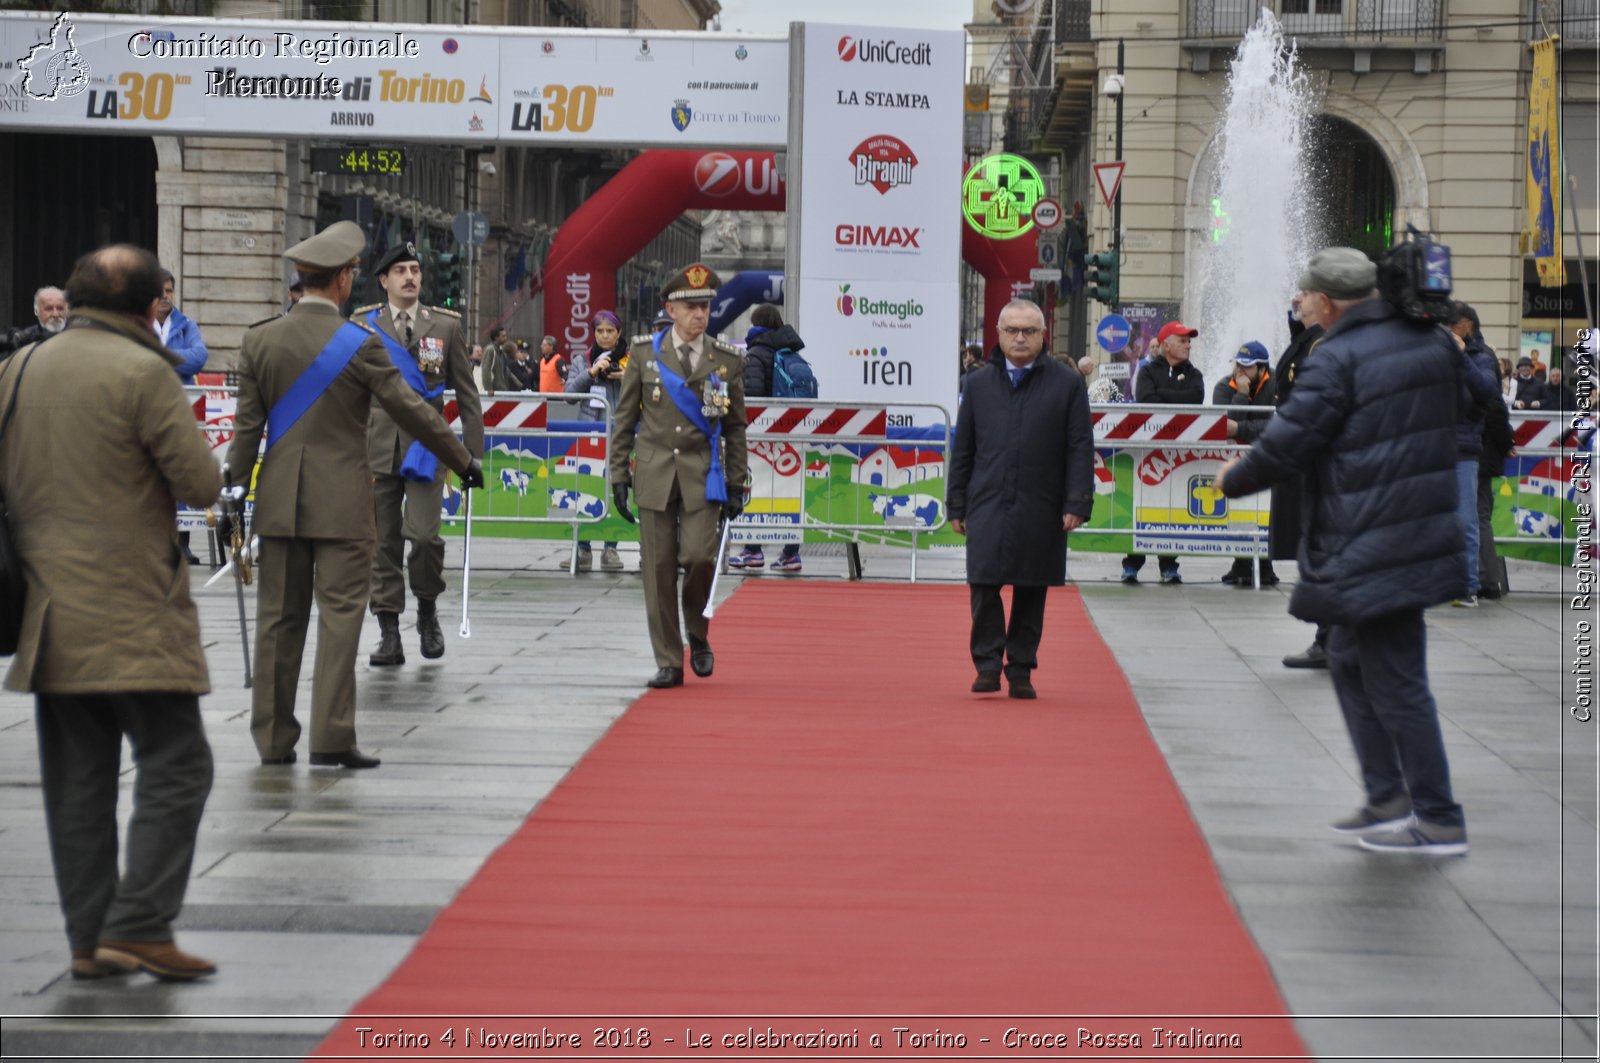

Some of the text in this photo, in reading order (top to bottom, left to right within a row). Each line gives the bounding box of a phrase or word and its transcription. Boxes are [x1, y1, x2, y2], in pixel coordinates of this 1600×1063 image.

[859, 39, 932, 66] UniCredit
[342, 77, 372, 102] di
[379, 69, 466, 104] Torino
[687, 80, 704, 90] con
[712, 81, 750, 92] patrocinio
[837, 90, 931, 109] LA STAMPA
[330, 111, 375, 127] ARRIVO
[855, 153, 913, 188] Biraghi
[835, 224, 920, 248] GIMAX
[859, 297, 923, 320] Battaglio
[1122, 306, 1158, 319] ICEBERG
[1535, 295, 1574, 312] Store
[863, 360, 912, 386] iren
[885, 412, 914, 428] san
[176, 518, 197, 528] Per
[1136, 540, 1154, 549] Per
[1156, 542, 1172, 550] noi
[1175, 542, 1184, 551] la
[1187, 542, 1222, 554] qualità
